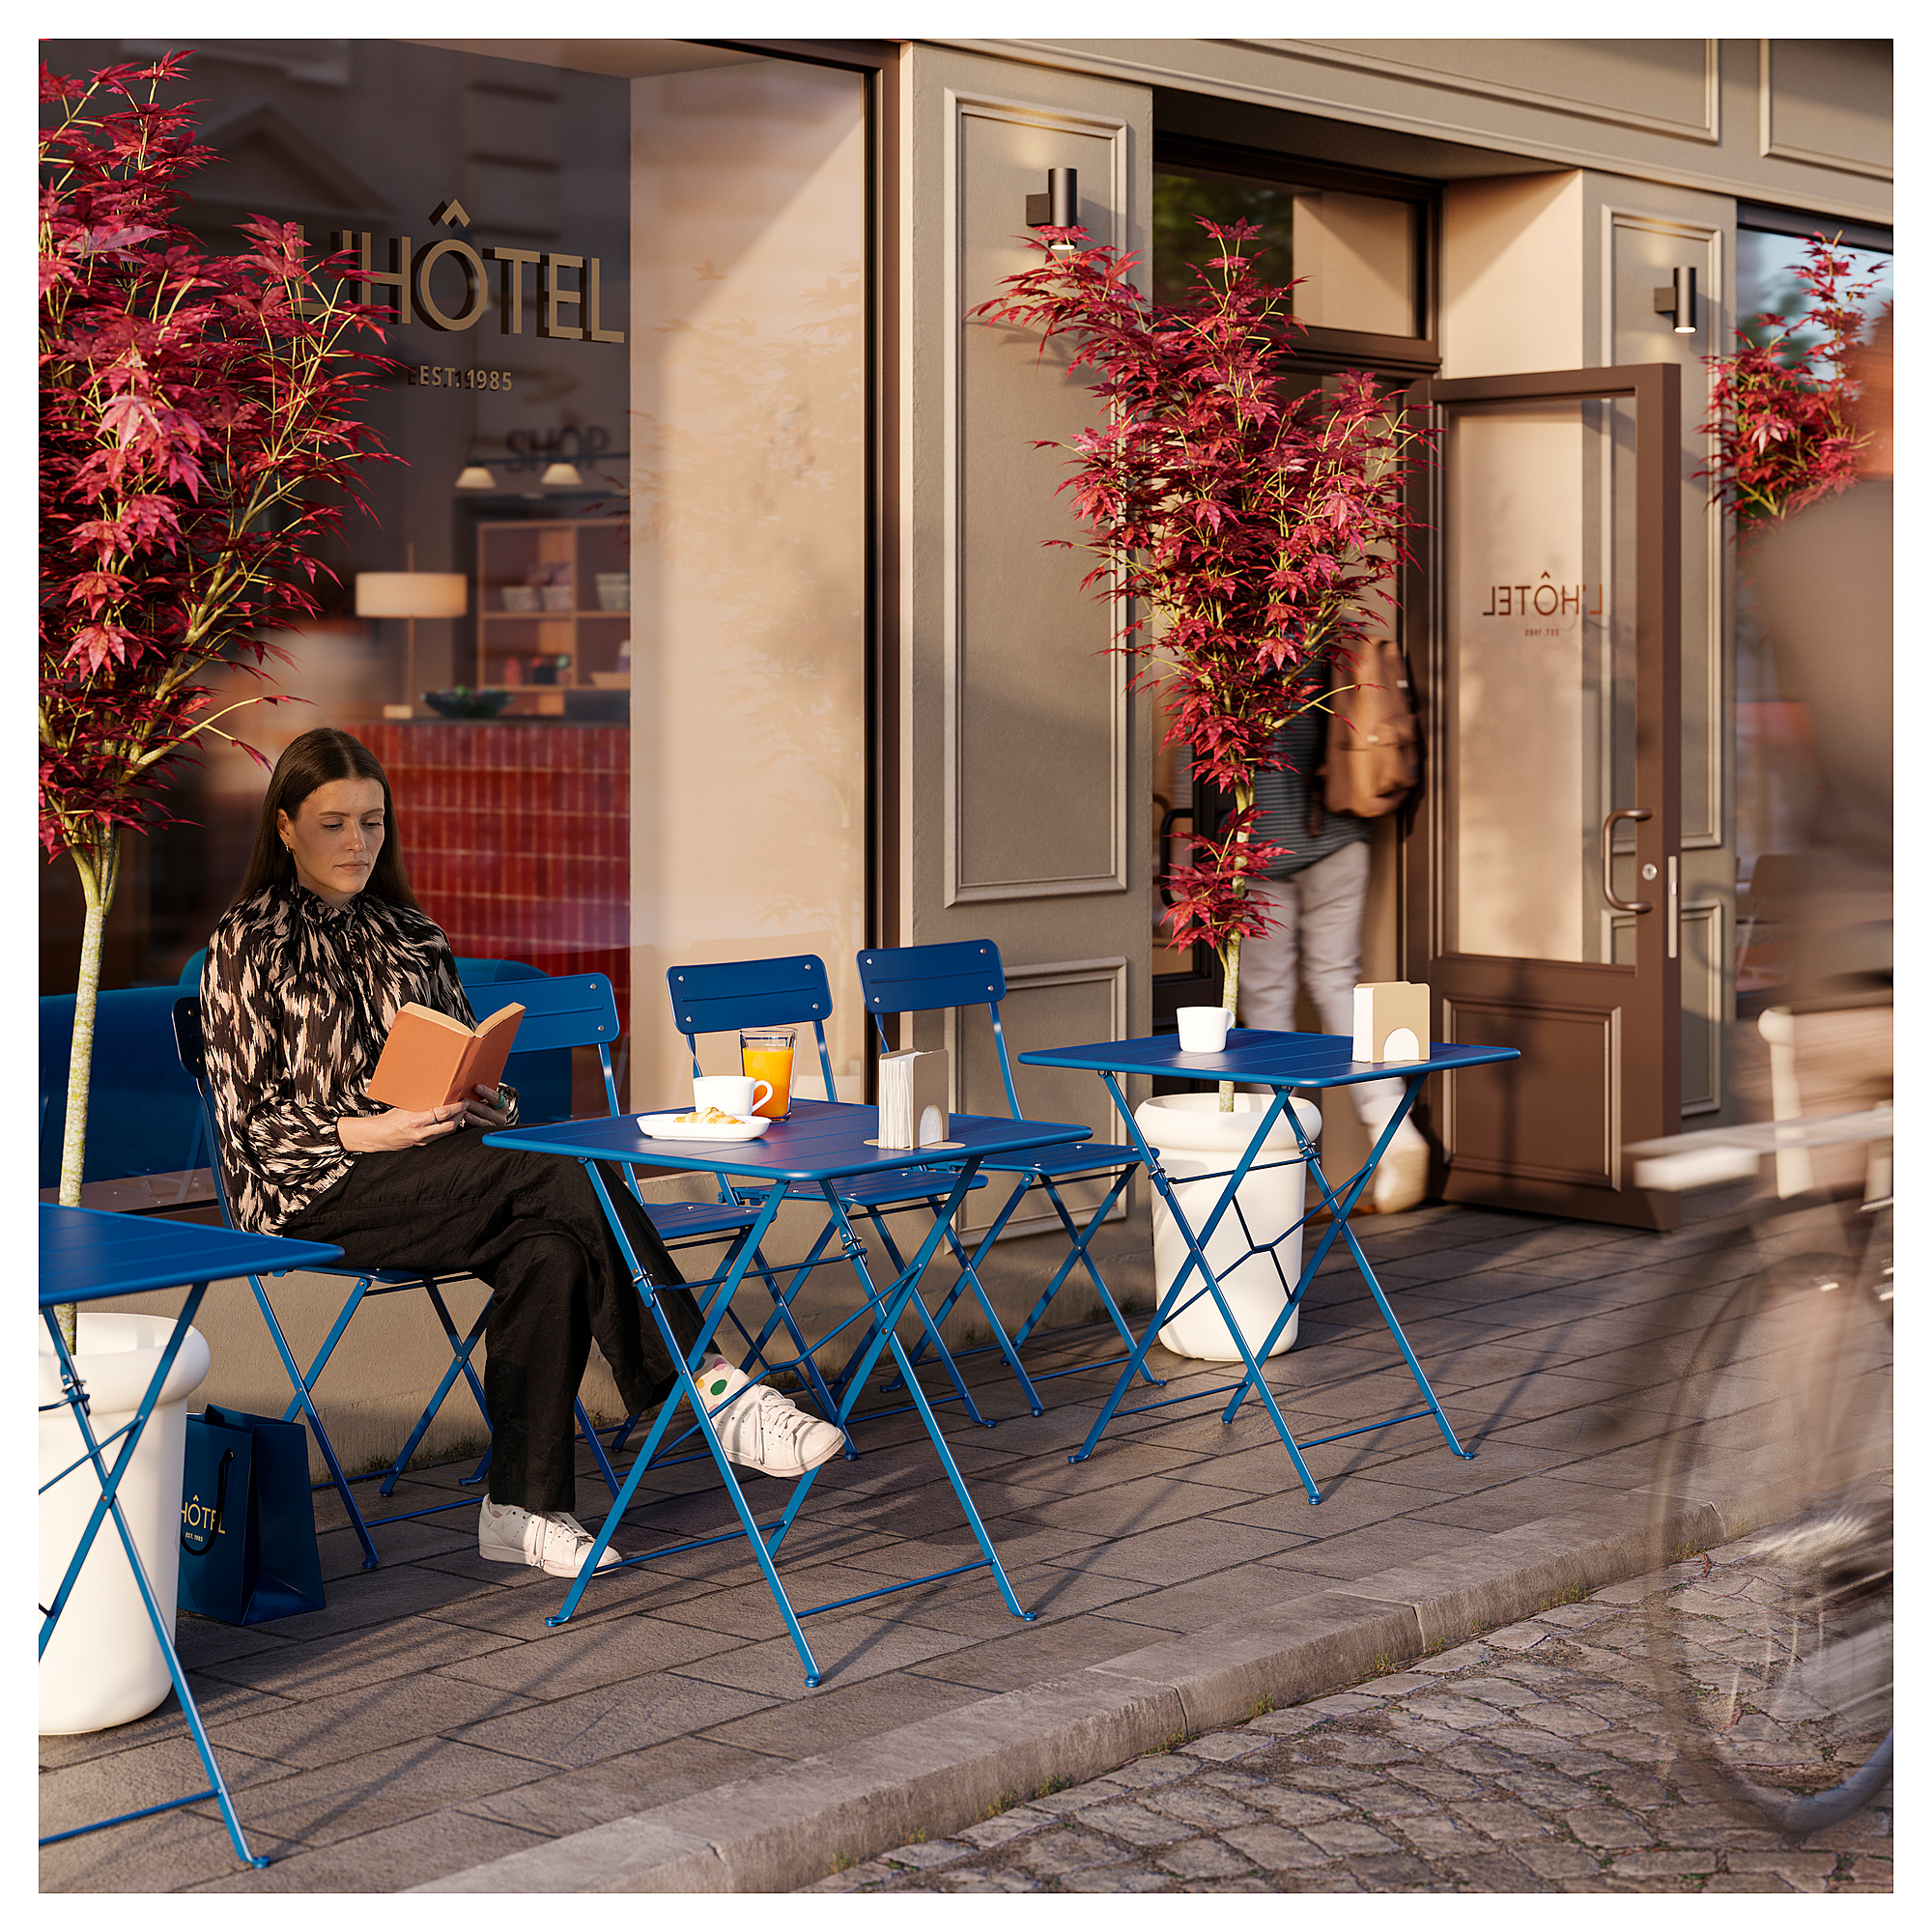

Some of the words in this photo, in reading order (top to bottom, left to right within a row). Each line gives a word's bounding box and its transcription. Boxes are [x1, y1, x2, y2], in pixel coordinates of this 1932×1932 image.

[419, 365, 461, 388] EST.
[467, 369, 513, 391] 1985
[505, 424, 611, 473] SHOP
